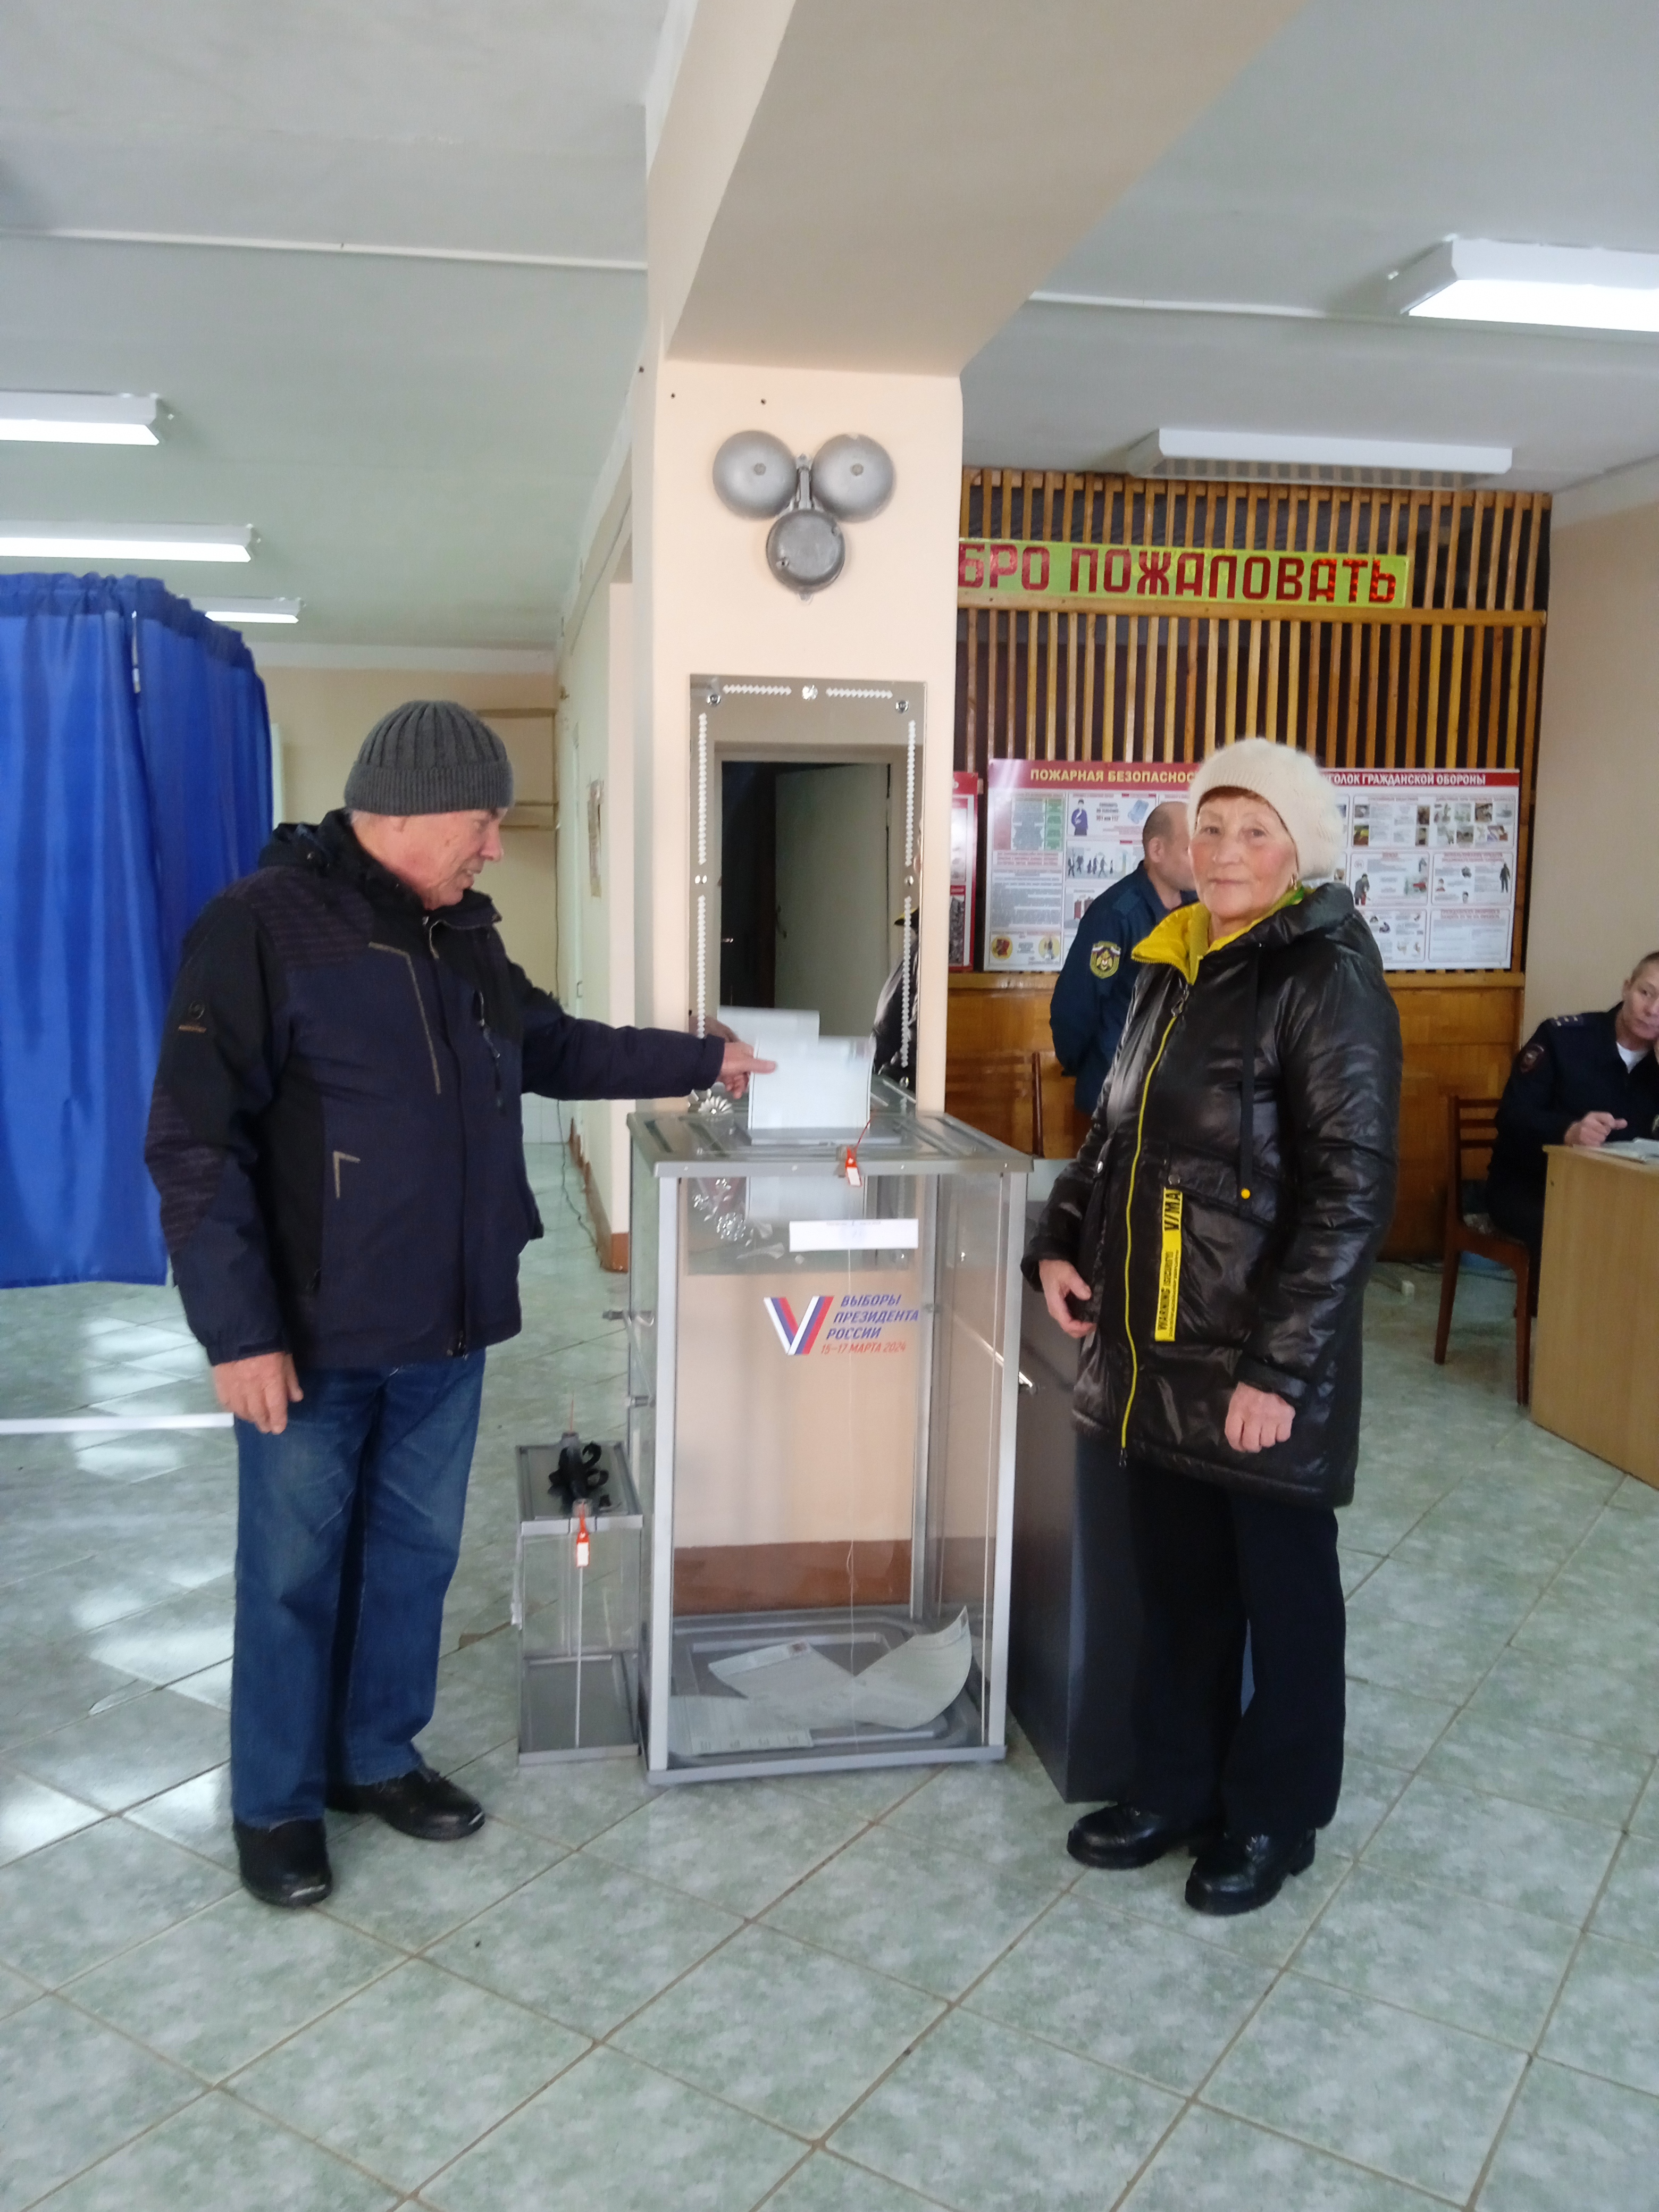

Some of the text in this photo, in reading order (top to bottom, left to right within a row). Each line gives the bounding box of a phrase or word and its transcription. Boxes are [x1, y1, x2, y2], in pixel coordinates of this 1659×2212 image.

[958, 543, 1396, 604] БРО ПОЖАЛОВАТЬ
[1030, 768, 1104, 782] ПОЖАРНАЯ
[1362, 773, 1435, 786] ГРАЖДАНСКОЙ
[1436, 775, 1486, 785] ОБОРОНЫ
[840, 1294, 902, 1308] ВЫБОРЫ
[833, 1310, 919, 1324] ПРЕЗИДЕНТА
[826, 1327, 882, 1340] РОССИИ
[850, 1342, 881, 1353] МАРТА
[883, 1341, 907, 1352] 2024
